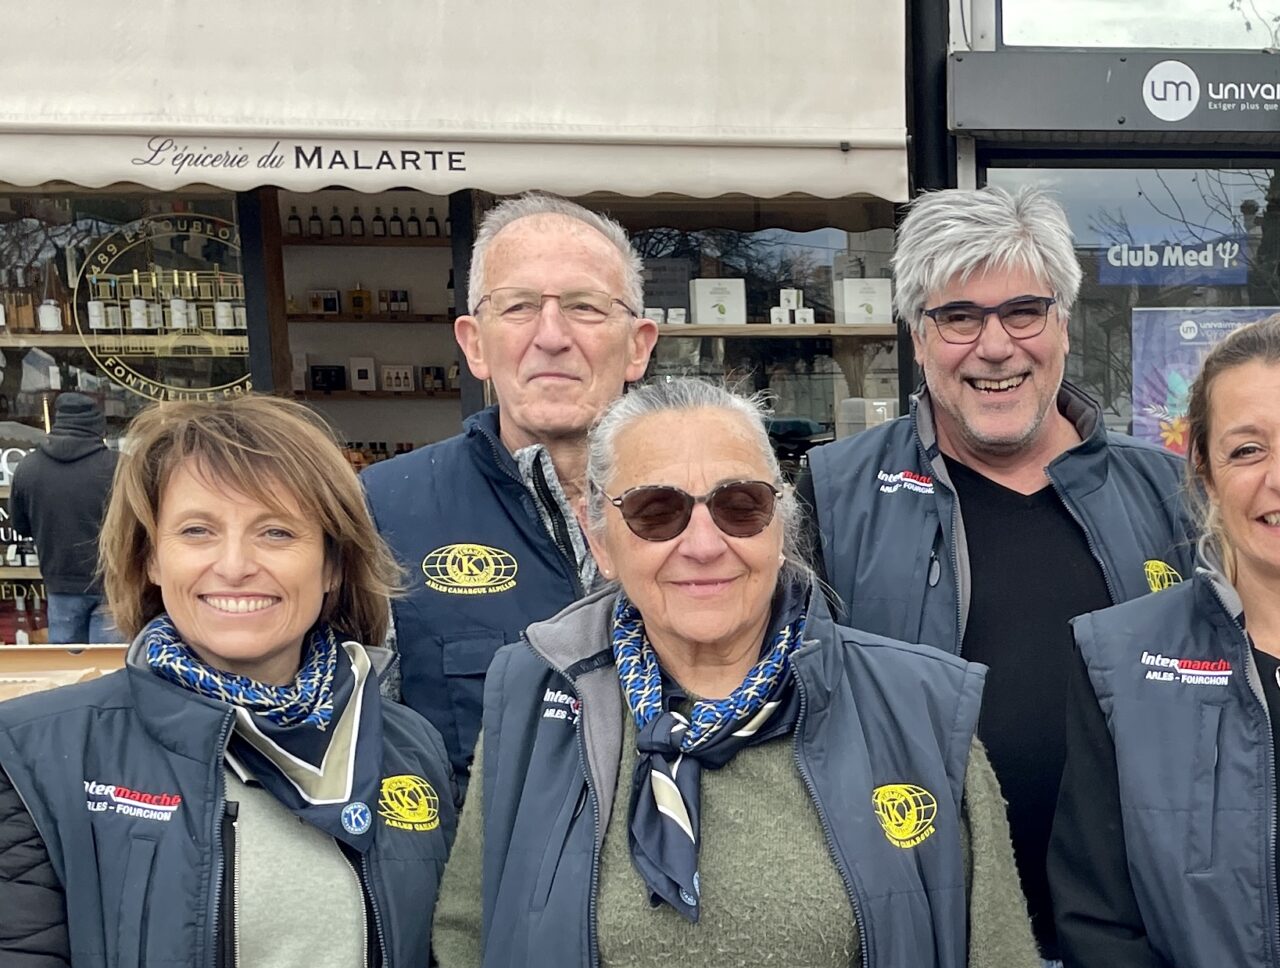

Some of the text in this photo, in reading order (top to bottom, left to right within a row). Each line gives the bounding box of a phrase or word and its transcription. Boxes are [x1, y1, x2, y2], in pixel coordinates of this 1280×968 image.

[1208, 101, 1236, 111] Exiger
[1240, 101, 1260, 111] plus
[1263, 102, 1279, 111] que
[131, 136, 467, 175] L'épicerie du MALARTE
[1107, 242, 1214, 267] Club Med
[461, 555, 482, 575] K
[1145, 671, 1175, 681] ARLES
[1181, 674, 1229, 686] FOURCHON
[116, 804, 172, 821] FOURCHON
[350, 808, 365, 828] K
